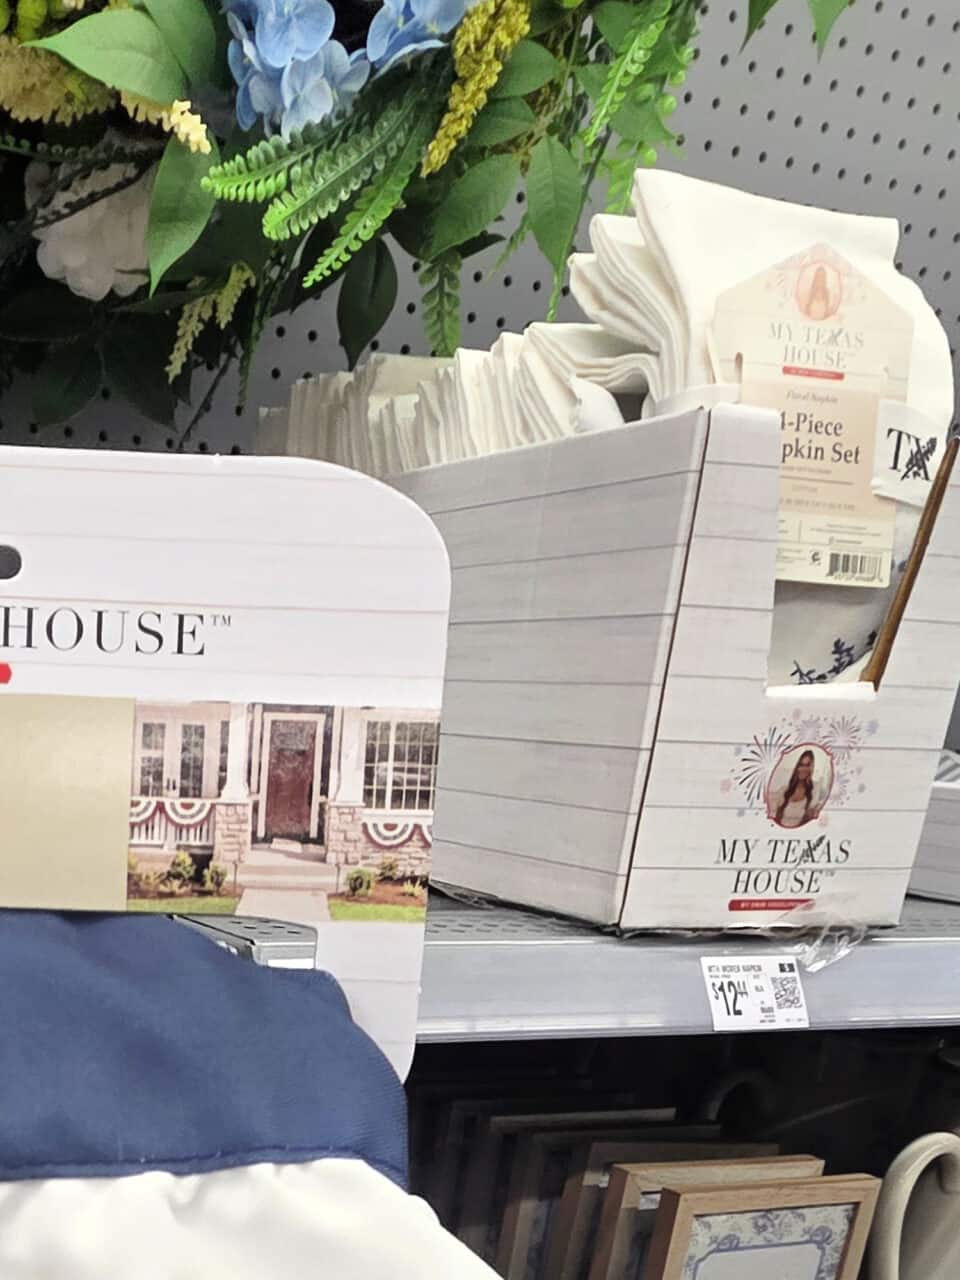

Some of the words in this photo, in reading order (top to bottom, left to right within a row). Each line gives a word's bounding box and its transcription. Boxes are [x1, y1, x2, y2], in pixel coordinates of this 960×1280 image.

[768, 322, 793, 340] MY
[831, 442, 860, 465] Set
[714, 838, 759, 864] MY
[767, 835, 852, 867] TEXAS
